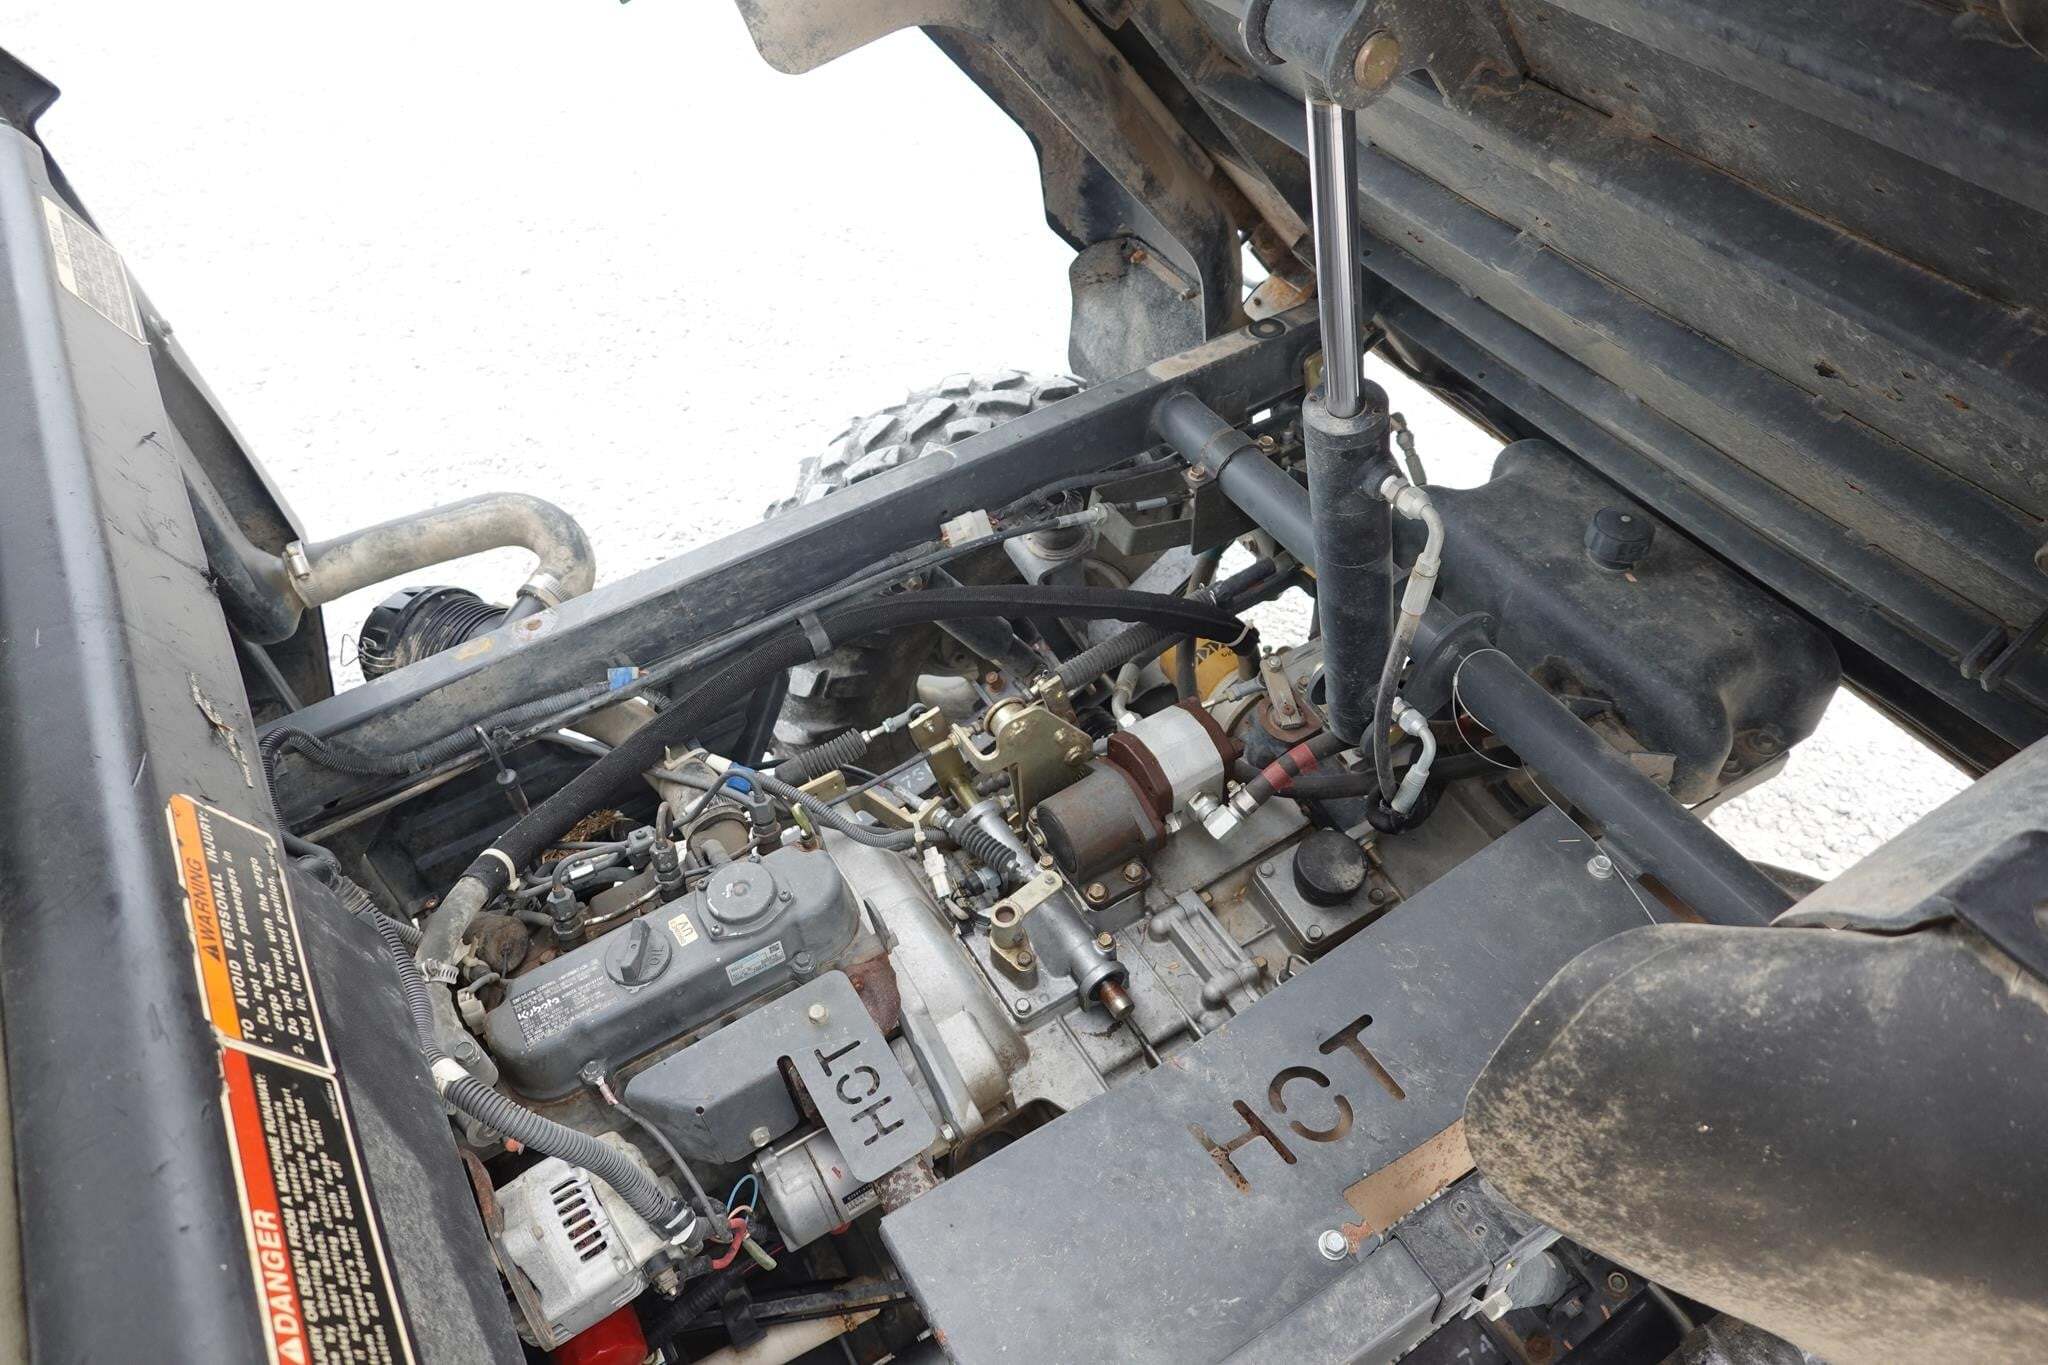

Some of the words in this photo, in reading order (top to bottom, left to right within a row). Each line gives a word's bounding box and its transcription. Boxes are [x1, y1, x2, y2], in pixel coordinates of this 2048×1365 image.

[196, 808, 218, 864] INJURY:
[220, 848, 233, 862] in
[249, 855, 266, 890] cargo
[185, 855, 217, 944] WARNING
[209, 869, 237, 951] PERSONAL
[225, 865, 252, 936] passengers
[255, 891, 270, 913] the
[264, 872, 288, 925] position.
[261, 915, 278, 943] with
[277, 926, 297, 966] raised
[241, 938, 260, 974] carry
[268, 946, 287, 984] travel
[649, 945, 664, 965] OIL
[227, 957, 250, 1009] AVOID
[248, 976, 264, 1001] not
[258, 958, 275, 989] bed.
[287, 969, 302, 992] the
[254, 1004, 270, 1026] Do
[267, 991, 287, 1033] cargo
[278, 987, 294, 1012] not
[293, 995, 307, 1011] in
[517, 997, 560, 1020] Kubota
[239, 1016, 258, 1042] TO
[259, 1029, 274, 1045] 1.
[284, 1014, 300, 1037] Do
[298, 1014, 315, 1042] bed
[290, 1039, 305, 1056] 2.
[253, 1071, 278, 1134] RUNAWAY:
[280, 1086, 296, 1114] start
[814, 1040, 904, 1146] HOT
[1187, 1014, 1406, 1196] HOT
[272, 1099, 294, 1155] terminals
[289, 1120, 304, 1145] may
[293, 1094, 317, 1153] bypassed.
[309, 1118, 325, 1145] shift
[266, 1134, 290, 1192] MACHINE
[294, 1149, 314, 1194] vehicle
[307, 1158, 320, 1171] is
[317, 1150, 337, 1185] range
[329, 1159, 344, 1178] off
[285, 1161, 304, 1202] starter
[279, 1194, 293, 1207] A
[305, 1199, 321, 1223] The
[312, 1176, 336, 1229] circuitry
[326, 1191, 343, 1218] with
[335, 1183, 355, 1220] outlet
[282, 1206, 302, 1247] FROM
[297, 1208, 316, 1252] across
[334, 1224, 352, 1251] seat
[312, 1229, 334, 1276] switch.
[326, 1235, 350, 1286] starting
[346, 1225, 373, 1284] hydraulic
[251, 1207, 301, 1336] DANGER
[291, 1249, 313, 1296] DEATH
[307, 1259, 333, 1317] shorting
[325, 1283, 343, 1315] start
[343, 1258, 371, 1325] operator's
[362, 1291, 380, 1316] and
[301, 1298, 319, 1321] OR
[339, 1293, 362, 1340] normal
[321, 1325, 338, 1342] by
